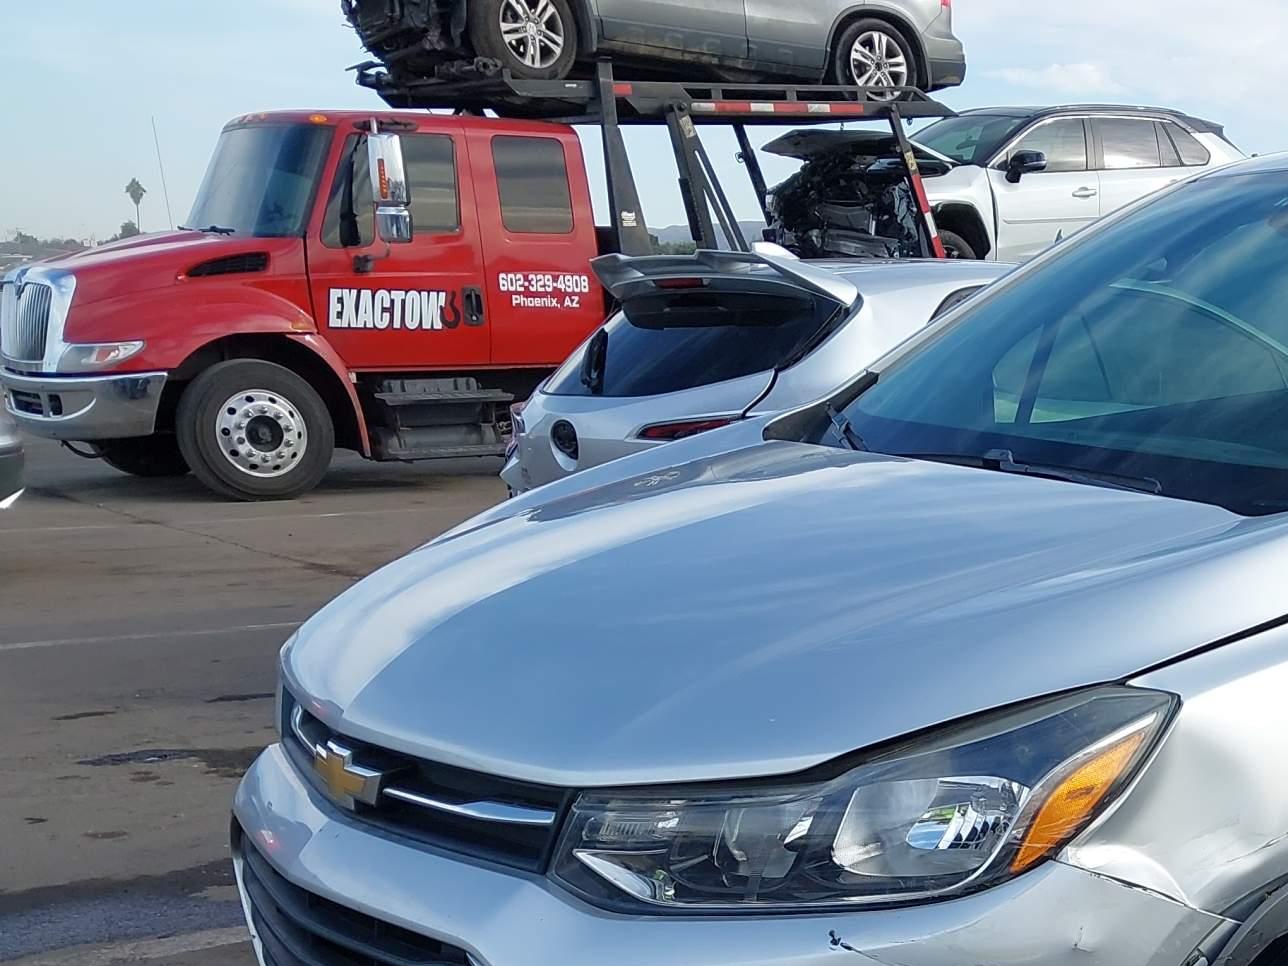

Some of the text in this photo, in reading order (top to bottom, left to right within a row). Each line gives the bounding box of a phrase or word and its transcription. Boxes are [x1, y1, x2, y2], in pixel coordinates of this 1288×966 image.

[498, 273, 589, 293] 602-329-4908
[328, 288, 447, 330] EXACTOW
[511, 295, 580, 308] Phoenix, AZ
